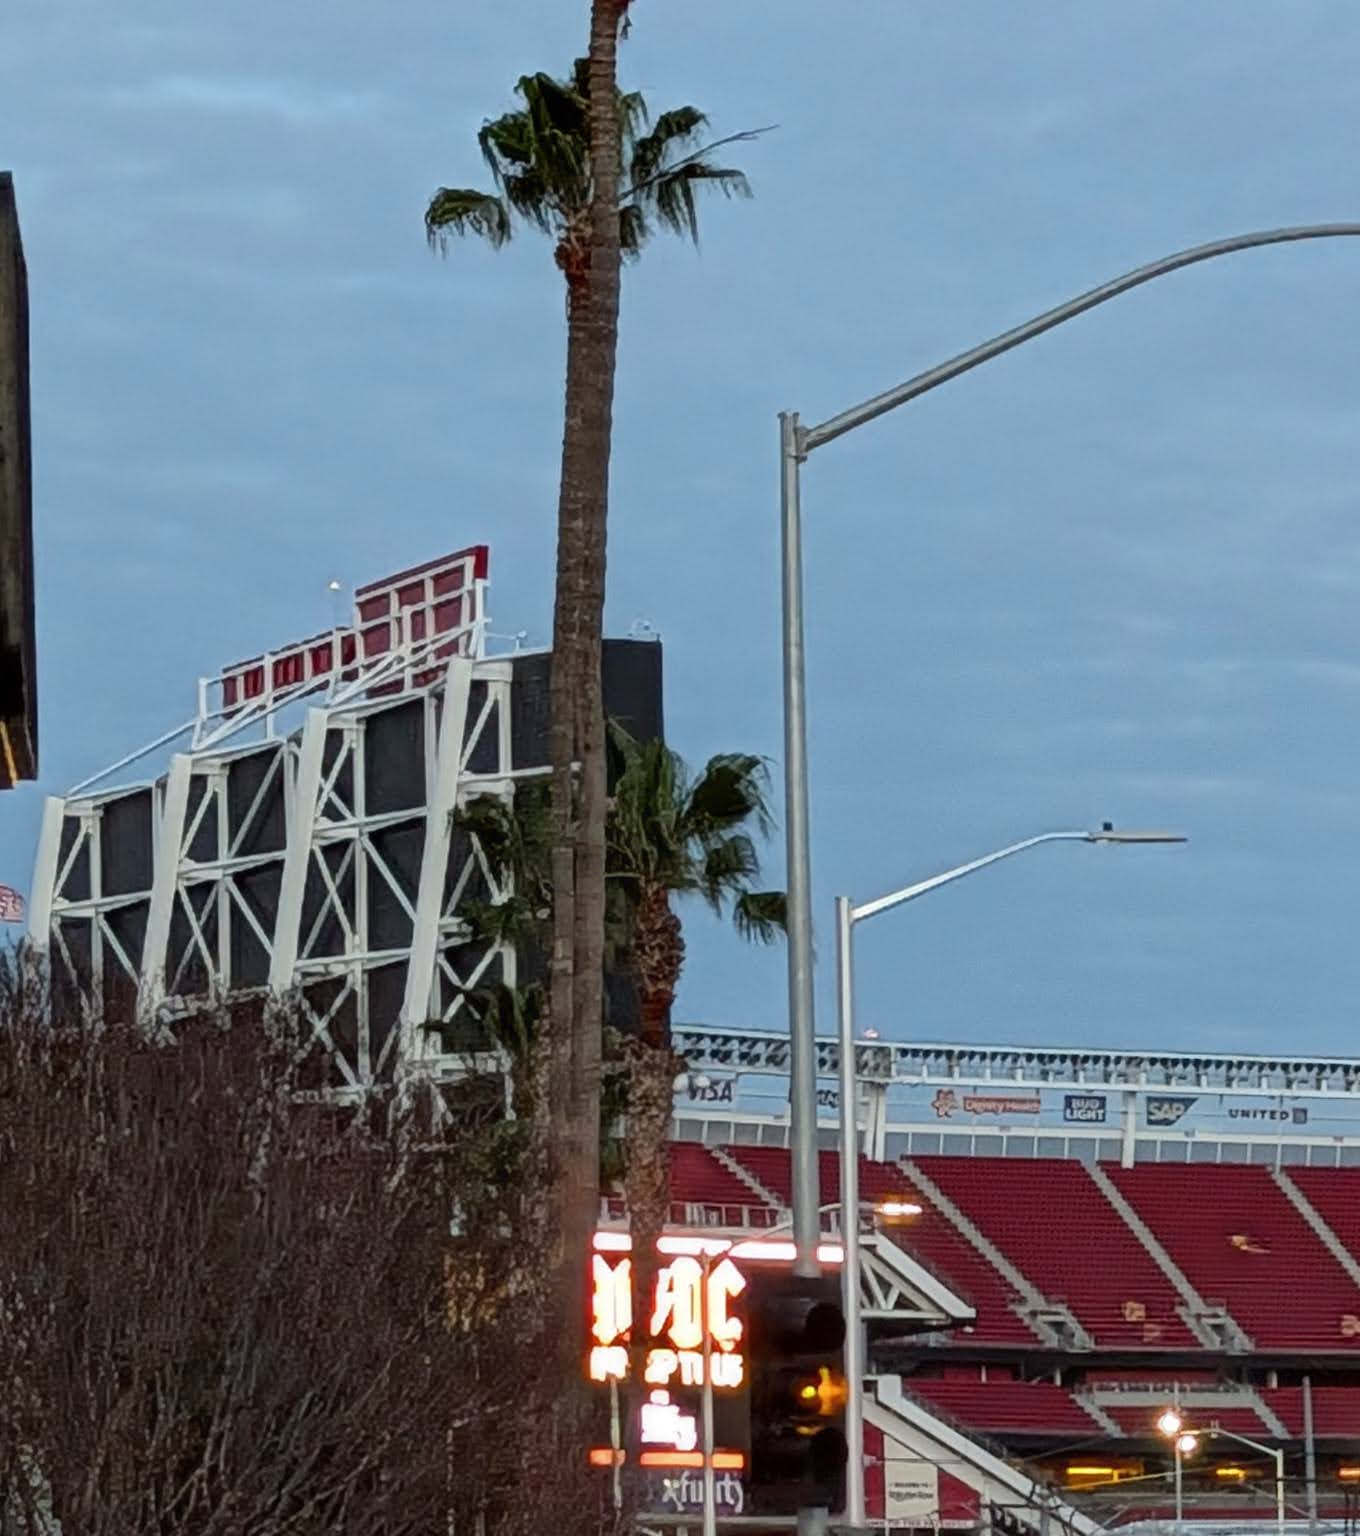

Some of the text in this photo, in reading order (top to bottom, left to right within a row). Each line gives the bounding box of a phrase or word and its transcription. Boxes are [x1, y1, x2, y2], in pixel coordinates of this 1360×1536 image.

[687, 1075, 732, 1102] VISA
[1071, 1098, 1099, 1110] BUD
[1065, 1109, 1105, 1121] LIGHT
[1149, 1102, 1185, 1120] SAP
[1228, 1108, 1290, 1121] UNITED
